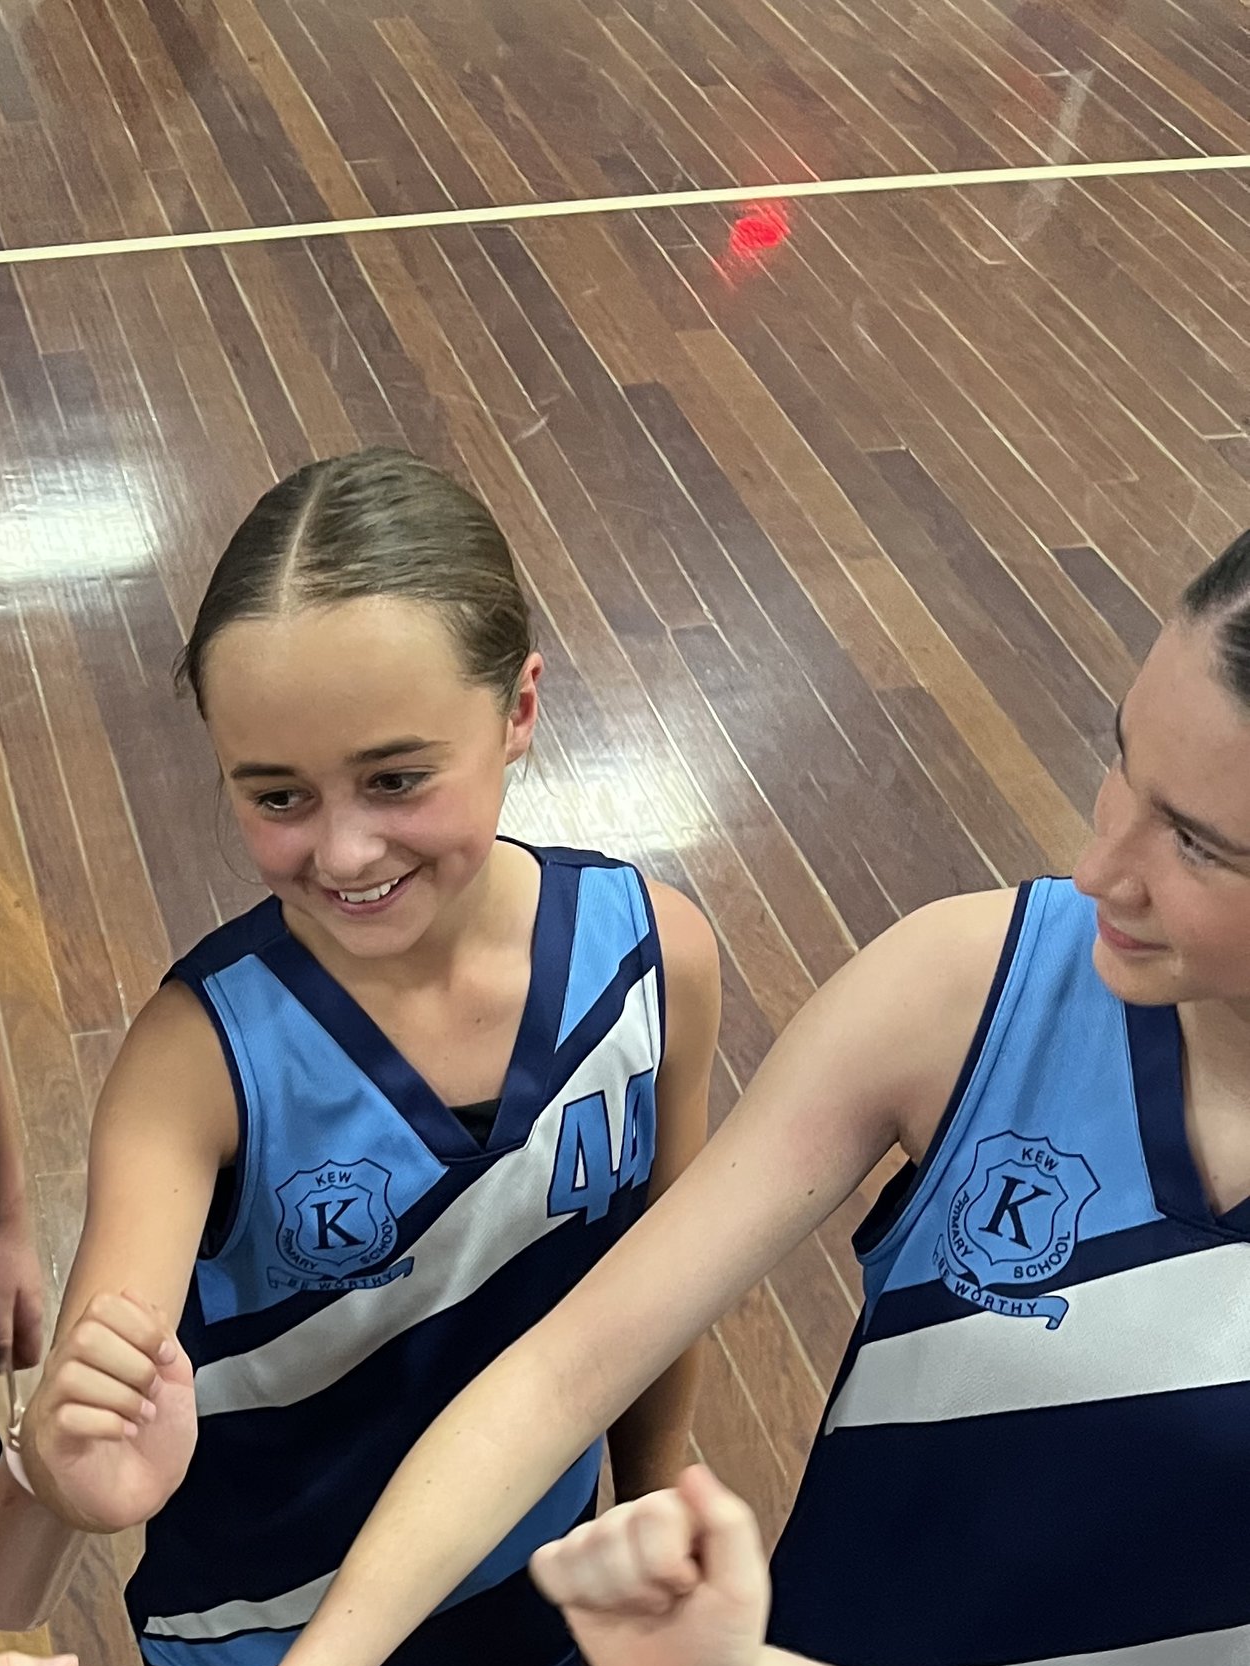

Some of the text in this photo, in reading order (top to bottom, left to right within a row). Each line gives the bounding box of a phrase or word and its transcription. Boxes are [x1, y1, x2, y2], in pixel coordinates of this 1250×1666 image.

[547, 1067, 656, 1226] 44
[1022, 1147, 1060, 1172] KEW
[315, 1171, 353, 1187] KEW
[310, 1197, 367, 1250] K
[949, 1190, 1071, 1279] PRIMARY SCHOOL
[978, 1175, 1052, 1250] K
[360, 1215, 393, 1265] SCHOOL
[318, 1272, 393, 1290] WORTHY
[954, 1280, 1038, 1315] WORTHY
